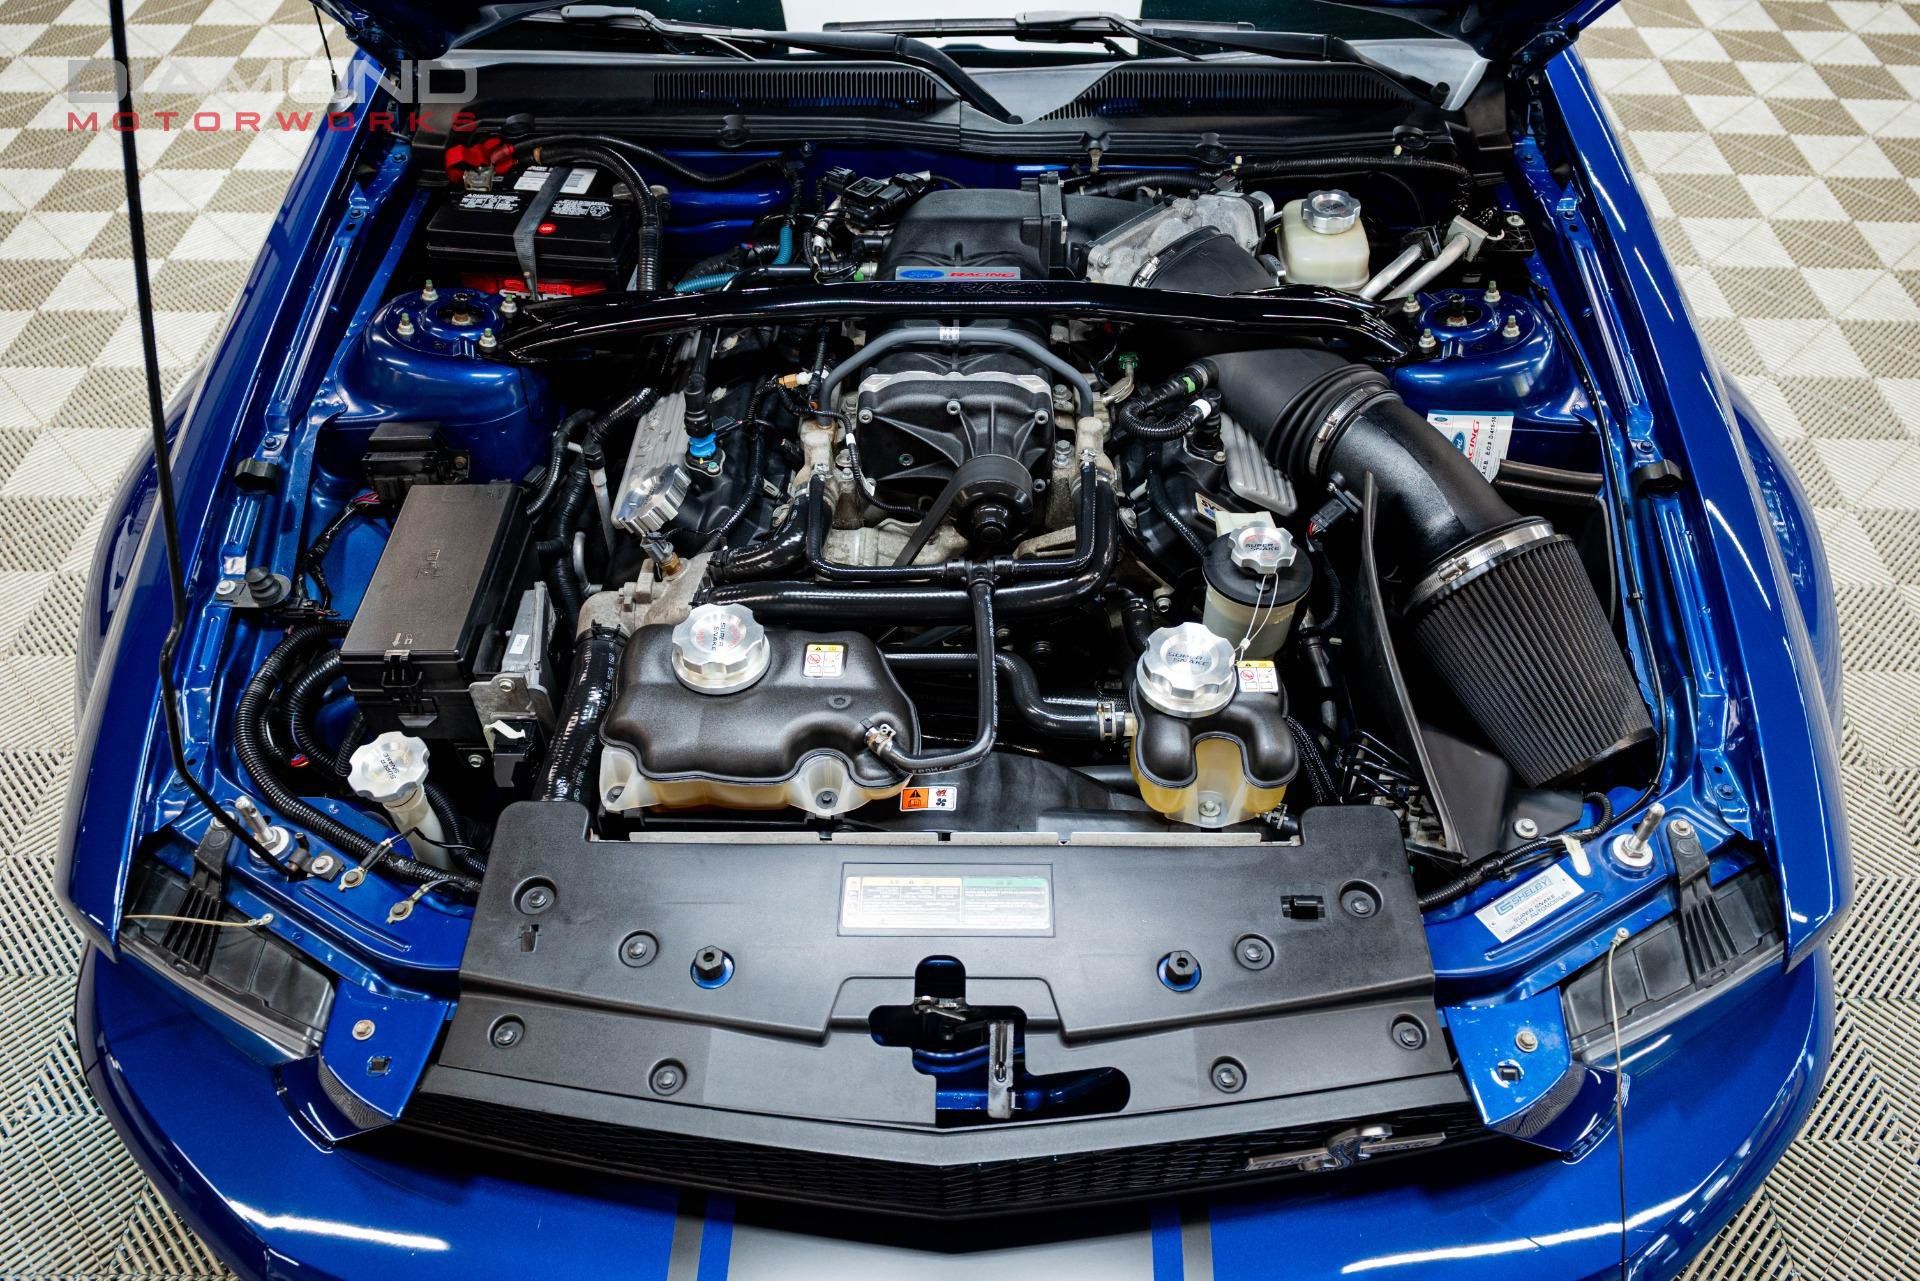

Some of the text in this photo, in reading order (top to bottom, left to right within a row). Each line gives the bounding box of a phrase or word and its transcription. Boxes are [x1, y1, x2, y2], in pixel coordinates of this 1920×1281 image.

[948, 271, 1017, 279] RACING
[1467, 419, 1480, 460] CING
[1511, 878, 1549, 905] SHELBY
[1513, 907, 1535, 923] SUPER
